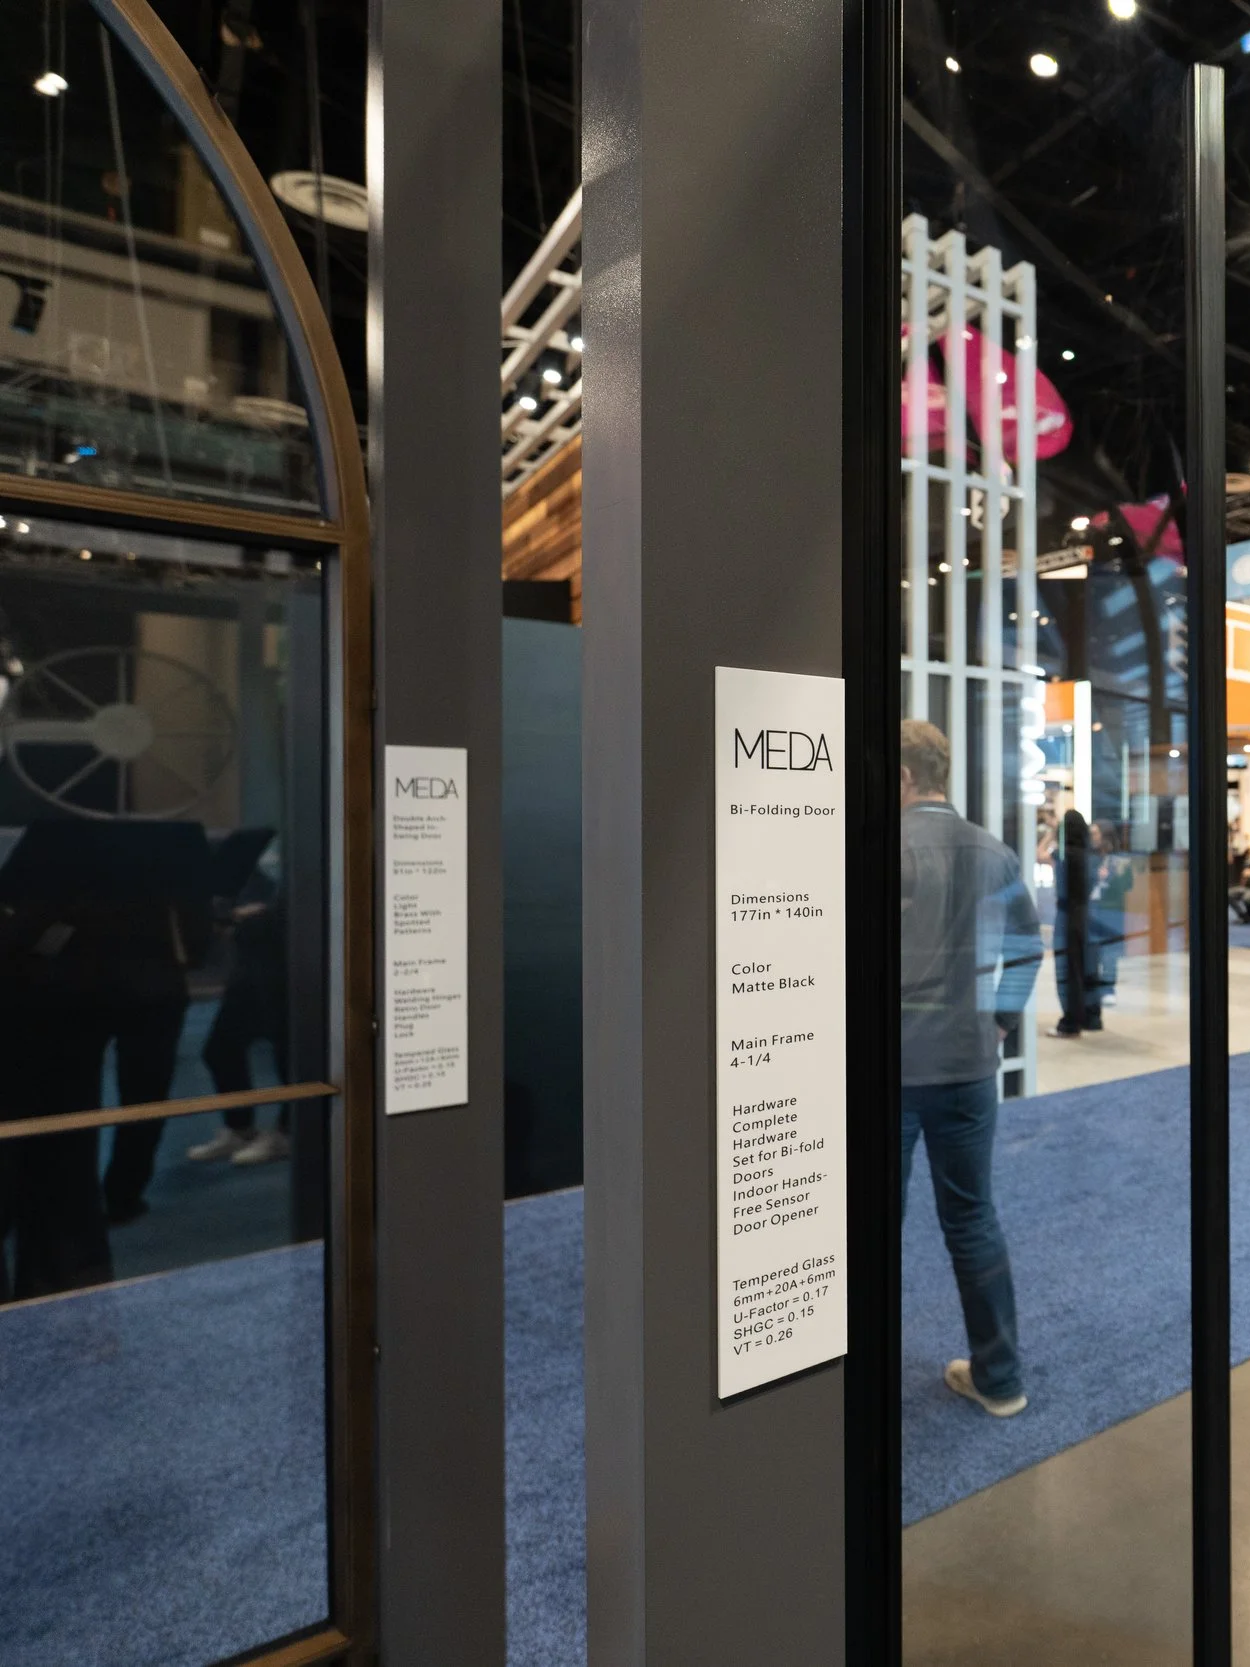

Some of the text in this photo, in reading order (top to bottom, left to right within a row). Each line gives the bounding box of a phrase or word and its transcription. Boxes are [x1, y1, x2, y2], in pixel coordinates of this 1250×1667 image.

[735, 728, 833, 772] MEDA
[395, 776, 459, 800] MEDA
[731, 804, 835, 818] Bi-Folding Door
[732, 892, 809, 905] Dimensions
[732, 909, 770, 921] 177in
[786, 906, 822, 918] 140in
[418, 958, 446, 966] Frame
[732, 962, 772, 975] Color
[732, 976, 814, 994] Matte Black
[732, 1032, 814, 1051] Main Frame
[730, 1052, 771, 1068] 4-1/4
[733, 1098, 796, 1116] Hardware
[733, 1114, 797, 1133] Complete
[734, 1130, 797, 1150] Hardware
[733, 1138, 824, 1167] Set for Bi-fold
[734, 1168, 773, 1184] Doors
[734, 1172, 827, 1201] Indoor Hands-
[734, 1192, 810, 1218] Free Sensor
[734, 1206, 818, 1235] Door Opener
[732, 1255, 834, 1291] Tempered Glass
[734, 1300, 789, 1324] U-Factor
[803, 1286, 828, 1302] 0.17
[734, 1318, 773, 1340] SHGC
[788, 1305, 814, 1322] 0.15
[734, 1341, 752, 1355] VT
[766, 1328, 792, 1345] 0.26
